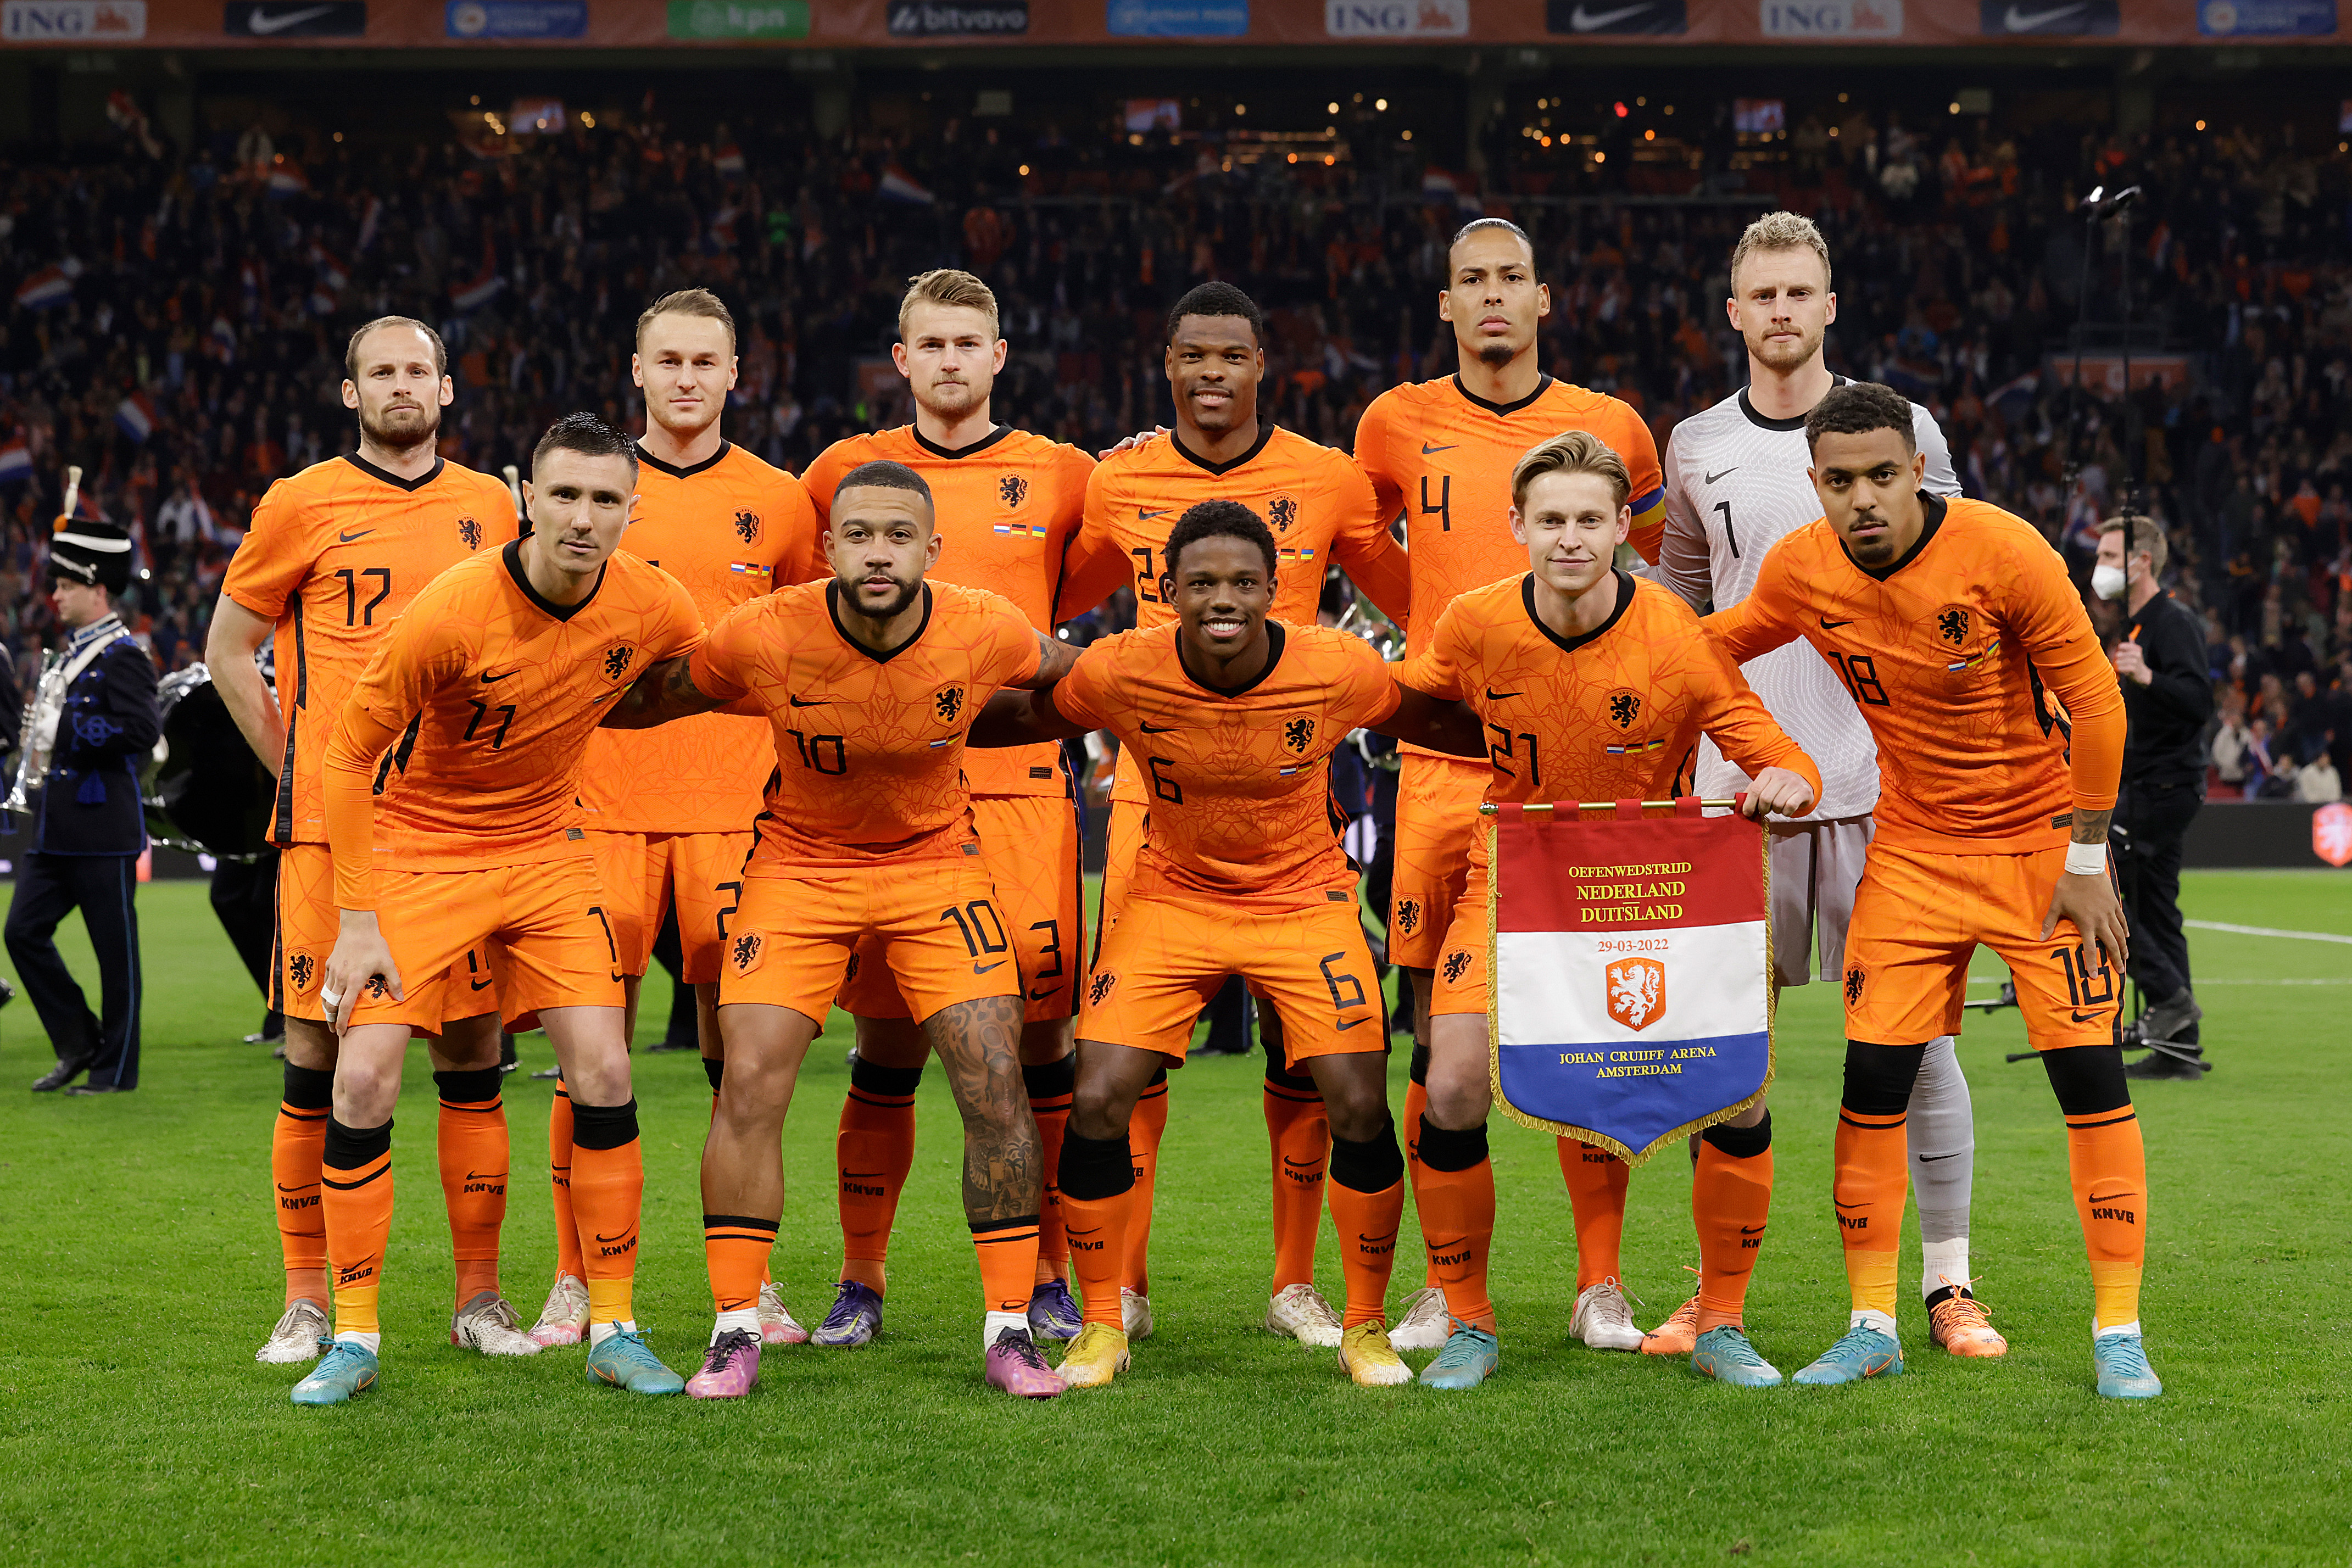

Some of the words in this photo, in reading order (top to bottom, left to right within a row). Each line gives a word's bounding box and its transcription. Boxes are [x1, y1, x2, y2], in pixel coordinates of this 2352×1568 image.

[11, 7, 83, 32] ING
[728, 5, 786, 34] kpn
[1335, 6, 1406, 28] ING
[1770, 5, 1840, 29] ING
[1422, 475, 1450, 532] 4
[1713, 500, 1740, 559] 1
[334, 568, 391, 626] 17
[1828, 651, 1891, 707] 18
[785, 729, 847, 776] 10
[1487, 723, 1540, 786] 21
[1148, 756, 1183, 806] 6
[1569, 862, 1692, 878] OEFENWEDSTRIJD
[1576, 881, 1686, 900] NEDERLAND
[1581, 904, 1683, 923] DUITSLAND
[940, 900, 1008, 957] 10
[1028, 919, 1063, 979] 3
[1597, 938, 1669, 952] 29-03-2022
[1318, 951, 1367, 1011] 6
[1560, 1052, 1604, 1064] JOHAN
[1610, 1049, 1665, 1062] CRUIJFF
[1670, 1046, 1717, 1059] ARENA
[1596, 1063, 1682, 1078] AMSTERDAM
[1284, 1167, 1323, 1183] KNVB
[464, 1182, 505, 1195] KNVB
[281, 1195, 320, 1210] KNVB
[2092, 1208, 2135, 1225] KNVB
[601, 1235, 636, 1257] KNVB
[1433, 1250, 1472, 1265] KNVB
[341, 1266, 373, 1285] KNVB
